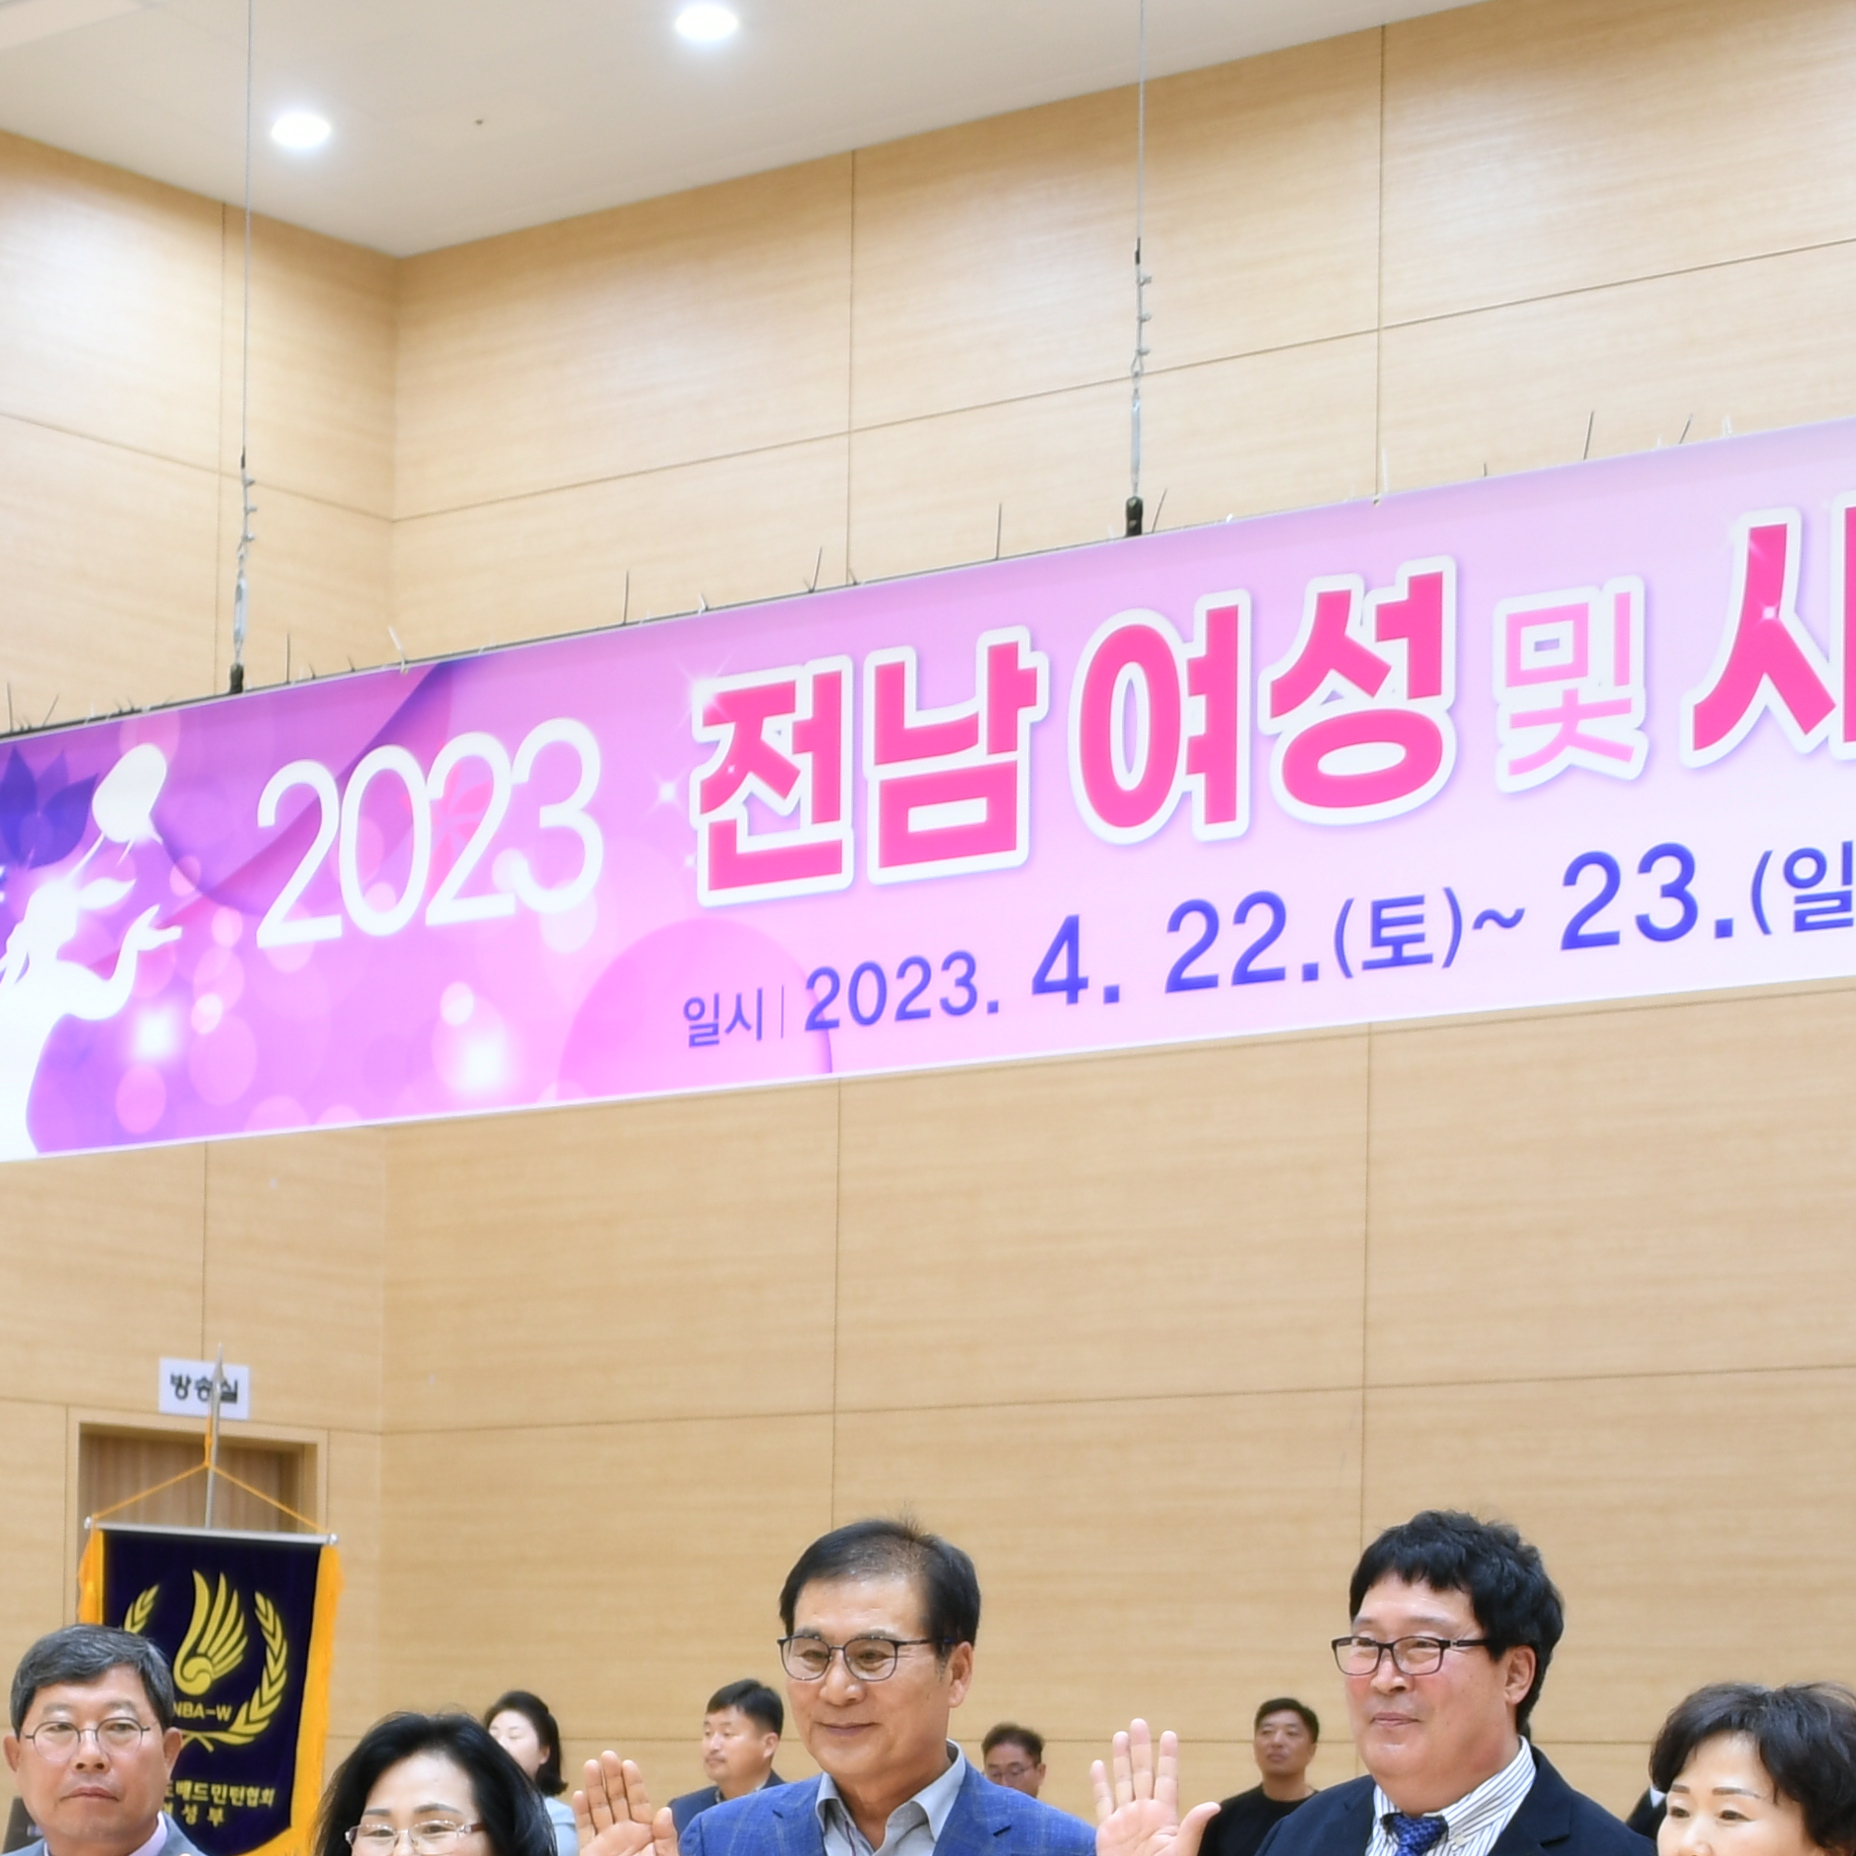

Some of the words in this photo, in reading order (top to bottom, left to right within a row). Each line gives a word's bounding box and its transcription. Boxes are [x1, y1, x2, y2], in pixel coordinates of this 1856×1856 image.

[255, 717, 604, 948] 2023
[698, 640, 1038, 892] 전남
[1079, 570, 1444, 829] 여성
[1504, 591, 1635, 776] 및
[682, 986, 763, 1048] 일시
[803, 950, 1000, 1032] 2023.
[1031, 914, 1121, 1006] 4.
[169, 1373, 238, 1405] 방송실
[173, 1701, 233, 1722] NBA-W
